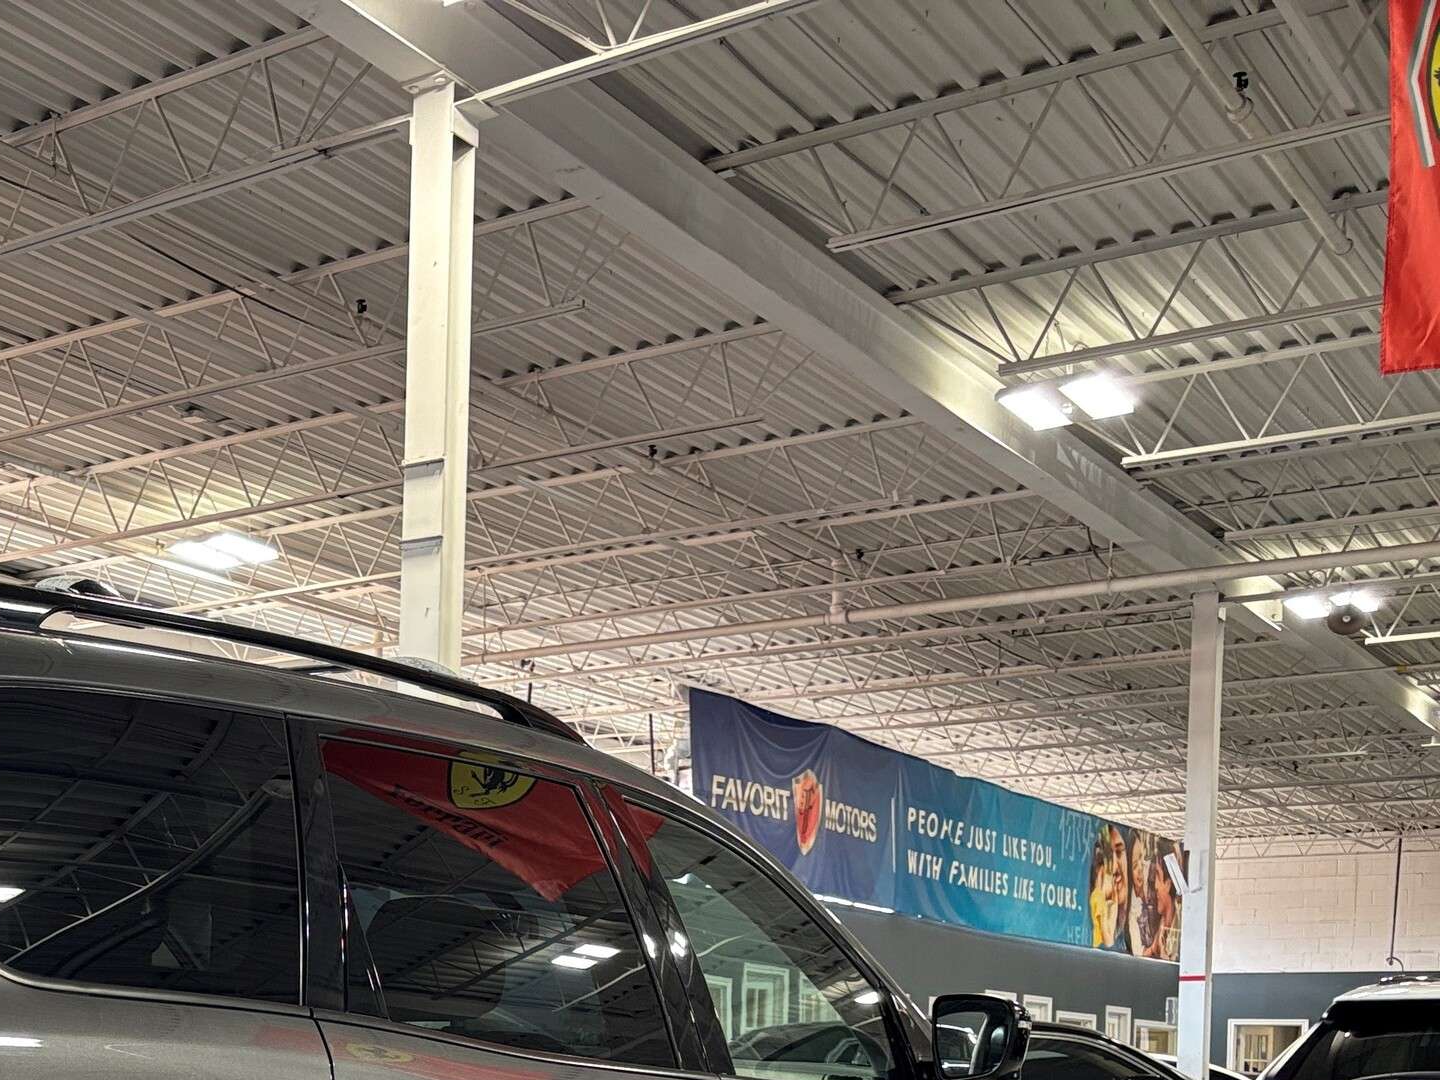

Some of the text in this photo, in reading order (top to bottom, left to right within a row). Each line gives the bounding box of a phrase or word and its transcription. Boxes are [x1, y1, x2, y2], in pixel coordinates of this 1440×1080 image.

[711, 774, 877, 843] FAVORIT MOTORS
[967, 825, 997, 854] JUST
[1002, 834, 1027, 861] LIKE
[1030, 841, 1056, 871] YOU,
[907, 849, 1082, 911] WITH FAMILIES LIKE YOURS.
